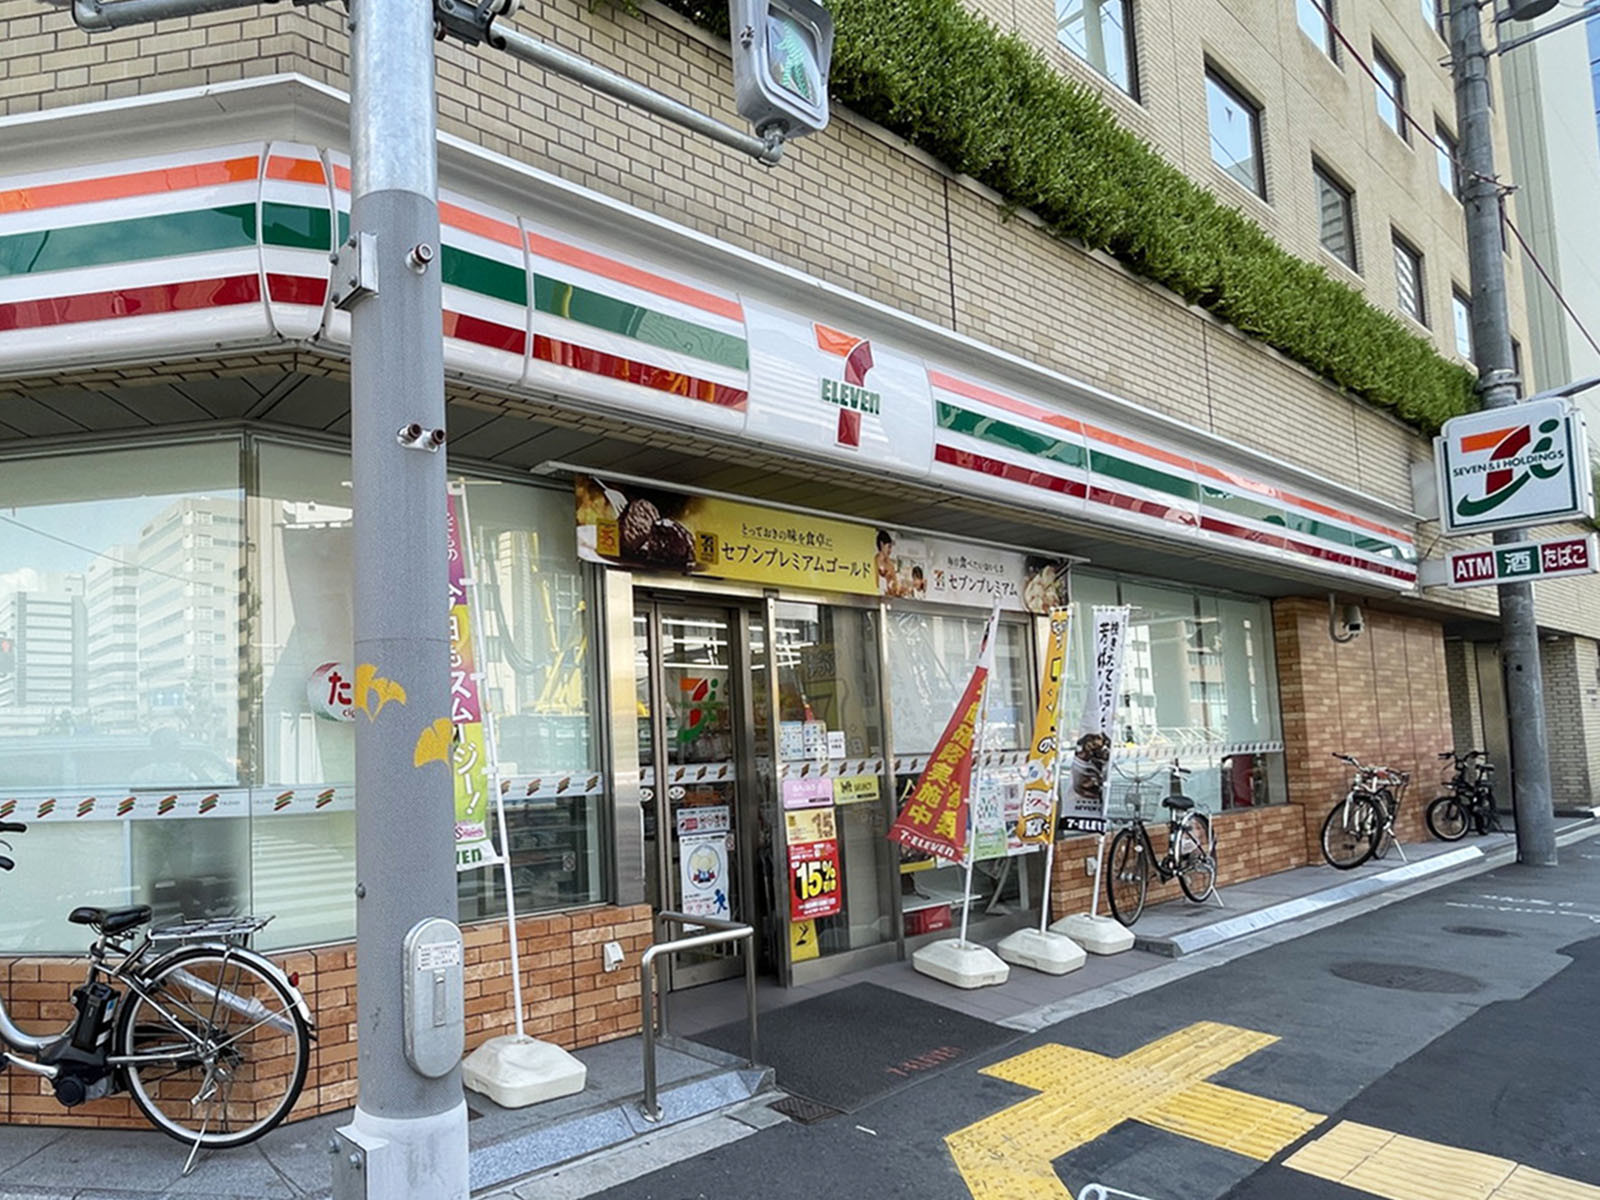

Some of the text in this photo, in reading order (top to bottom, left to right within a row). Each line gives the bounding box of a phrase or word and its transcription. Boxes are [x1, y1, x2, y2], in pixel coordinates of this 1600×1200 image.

[1503, 449, 1565, 468] HOLDINGS
[721, 541, 872, 579] セブンプレミアムゴールド
[1455, 556, 1493, 580] ATM
[1504, 550, 1532, 574] 酒
[1543, 543, 1587, 569] たばこ
[948, 573, 1018, 597] セブンプレミアム
